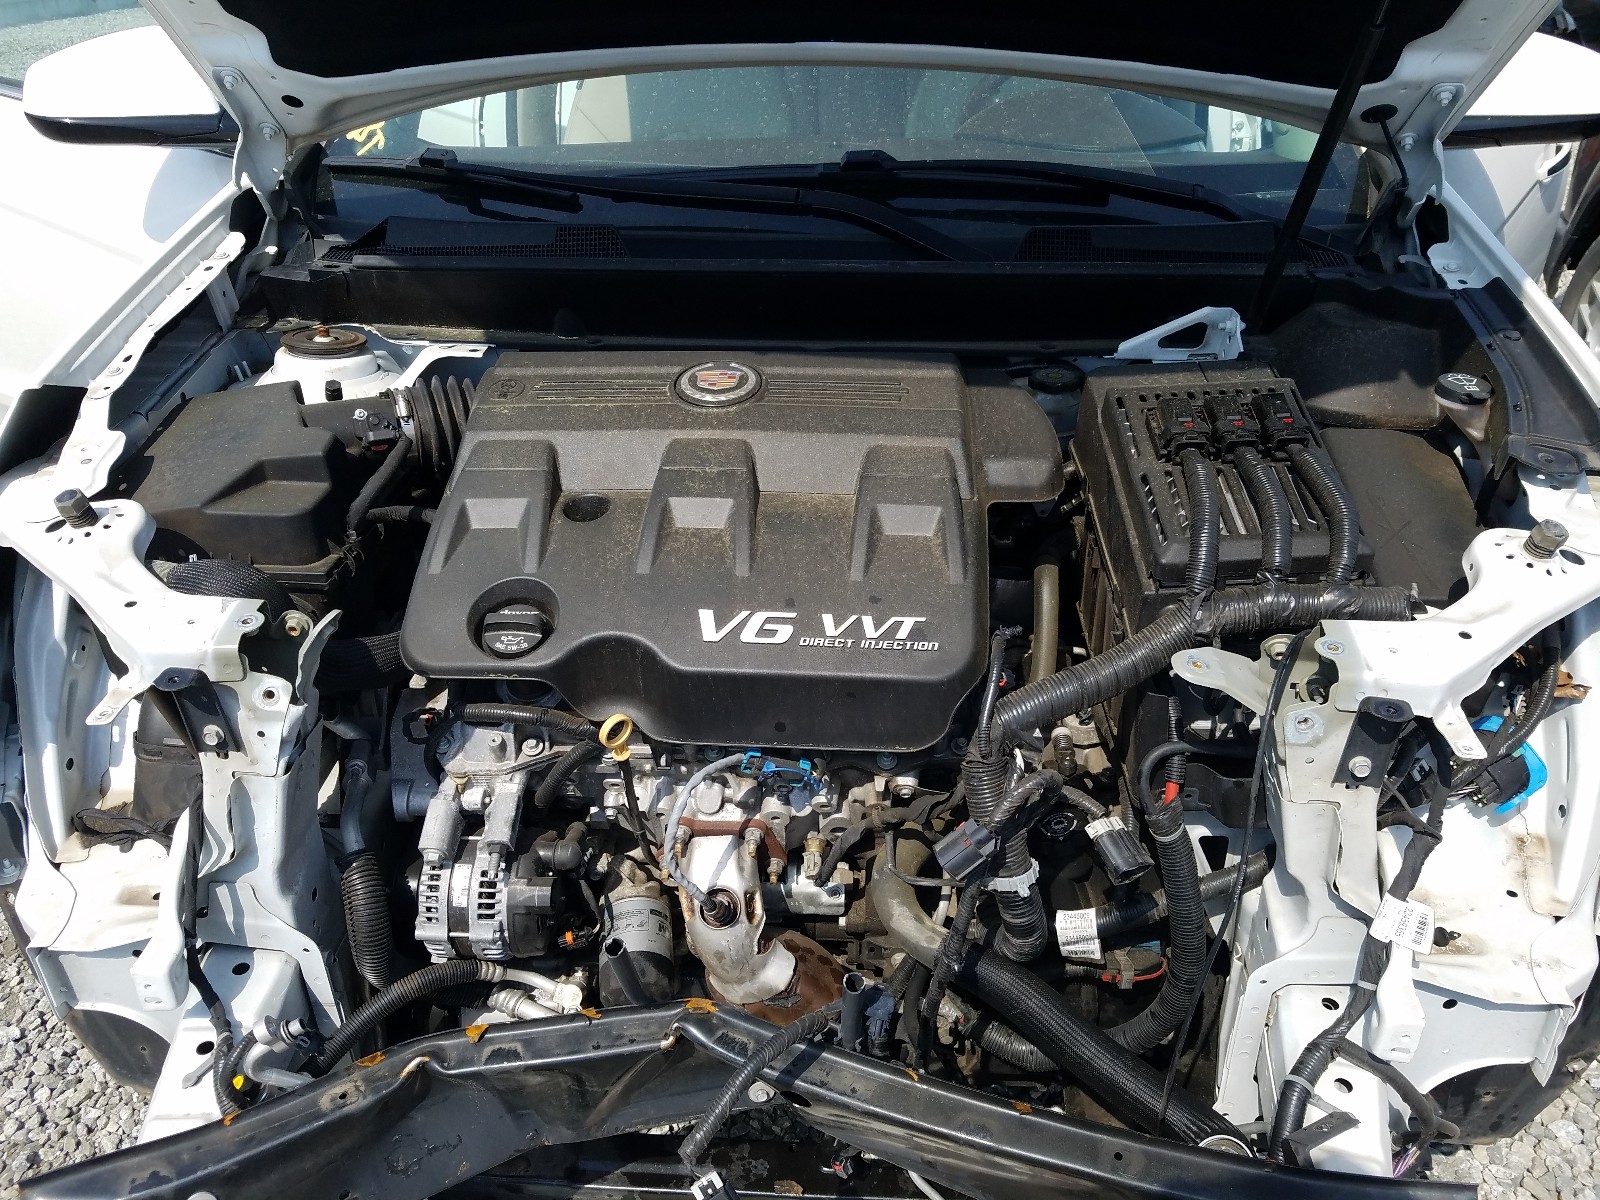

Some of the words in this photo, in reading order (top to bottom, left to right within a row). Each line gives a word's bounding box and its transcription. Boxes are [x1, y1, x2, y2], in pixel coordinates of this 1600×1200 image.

[698, 609, 798, 644] V6
[821, 613, 927, 640] VVT
[799, 638, 856, 648] DIRECT
[860, 639, 939, 651] INJECTION
